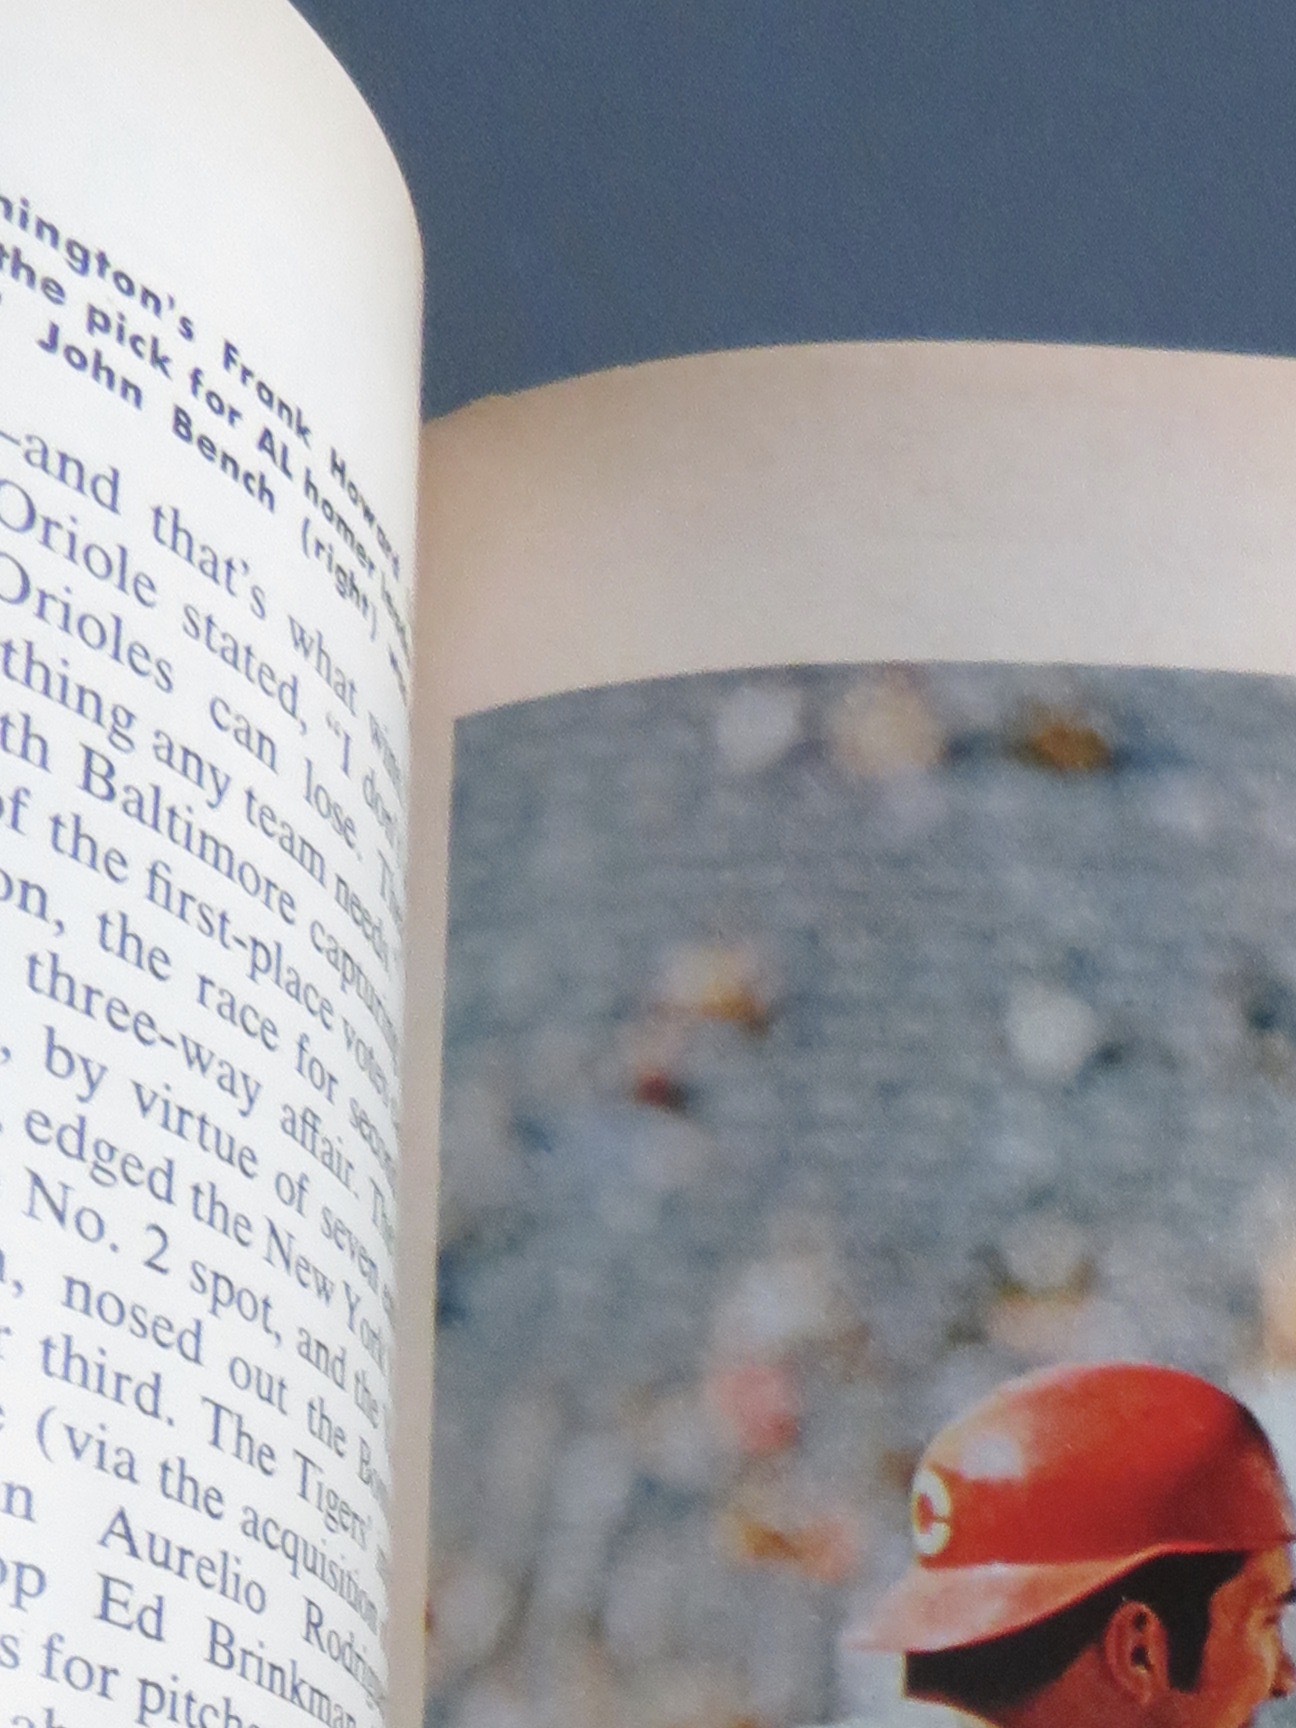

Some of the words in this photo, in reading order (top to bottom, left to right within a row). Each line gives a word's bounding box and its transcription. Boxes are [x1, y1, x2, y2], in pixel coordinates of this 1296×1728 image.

[37, 321, 143, 411] John
[172, 404, 276, 514] Bench
[86, 301, 172, 380] pick
[190, 367, 243, 428] for
[258, 425, 292, 481] AL
[304, 467, 375, 576] homer
[222, 338, 313, 450] Frank
[0, 478, 157, 608] Oriole
[182, 603, 308, 735] stated,
[0, 551, 173, 694] Orioles
[210, 696, 279, 775] can
[151, 504, 266, 620] that's
[288, 614, 358, 717] what
[0, 638, 136, 754] thing
[152, 728, 231, 810] any
[245, 786, 328, 890] team
[77, 742, 297, 926] Baltimore
[0, 786, 31, 836] f
[49, 812, 128, 884] the
[146, 859, 335, 1031] first-place
[26, 949, 262, 1118] three-way
[97, 910, 171, 983] the
[196, 973, 280, 1052] race
[295, 1032, 339, 1105] for
[24, 1108, 176, 1207] edged
[191, 1181, 253, 1248] the
[262, 1215, 336, 1307] New
[43, 1025, 108, 1103] by
[131, 1079, 259, 1180] virtue
[275, 1170, 309, 1218] of
[21, 1167, 119, 1254] No.
[143, 1223, 170, 1276] 2
[190, 1259, 282, 1348] spot,
[297, 1326, 348, 1391] and
[62, 1275, 204, 1367] nosed
[229, 1355, 289, 1415] out
[307, 1396, 347, 1458] the
[35, 1405, 140, 1486] (via
[160, 1456, 225, 1522] the
[39, 1333, 174, 1427] third.
[201, 1395, 276, 1477] The
[0, 1557, 47, 1613] p
[93, 1572, 166, 1643] Ed
[98, 1505, 266, 1616] Aurelio
[39, 1632, 120, 1700] for
